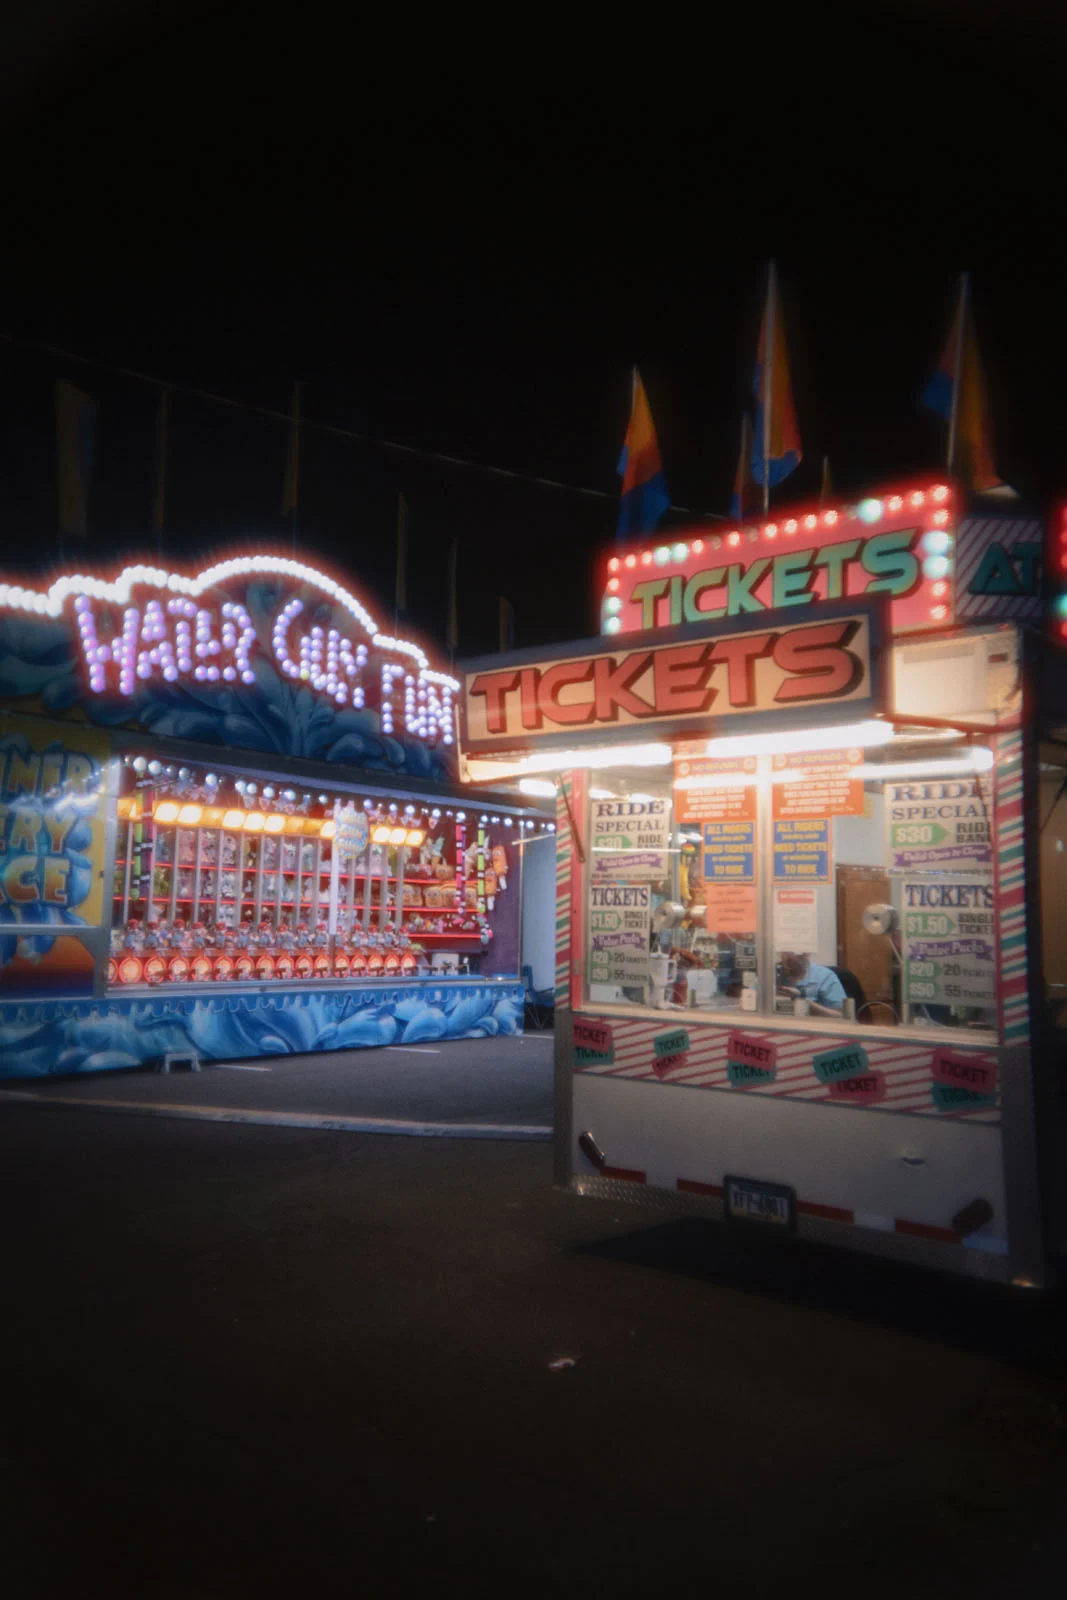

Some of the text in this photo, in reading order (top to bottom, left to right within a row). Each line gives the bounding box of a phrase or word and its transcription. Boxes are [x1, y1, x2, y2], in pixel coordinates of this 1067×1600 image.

[631, 527, 920, 630] TICKETS
[75, 595, 453, 745] WATER GUN FUN
[469, 618, 864, 734] TICKETS
[0, 752, 92, 797] NER
[892, 783, 992, 800] RIDE
[596, 801, 664, 817] RIDE
[595, 820, 664, 832] SPECIAL
[707, 825, 721, 834] ALL
[777, 823, 792, 832] ALL
[896, 825, 932, 842] $30
[956, 834, 990, 843] BAN
[0, 856, 70, 903] CE
[592, 887, 648, 907] TICKETS
[905, 885, 993, 908] TICKETS
[908, 915, 948, 934] $1.50
[613, 951, 625, 963] 20
[943, 964, 960, 976] 20
[944, 984, 960, 997] 55
[573, 1024, 607, 1045] TICKET
[659, 1036, 686, 1053] TICKET
[733, 1040, 771, 1061] TICKET
[820, 1052, 861, 1077] TICKET
[940, 1058, 989, 1085] TICKET
